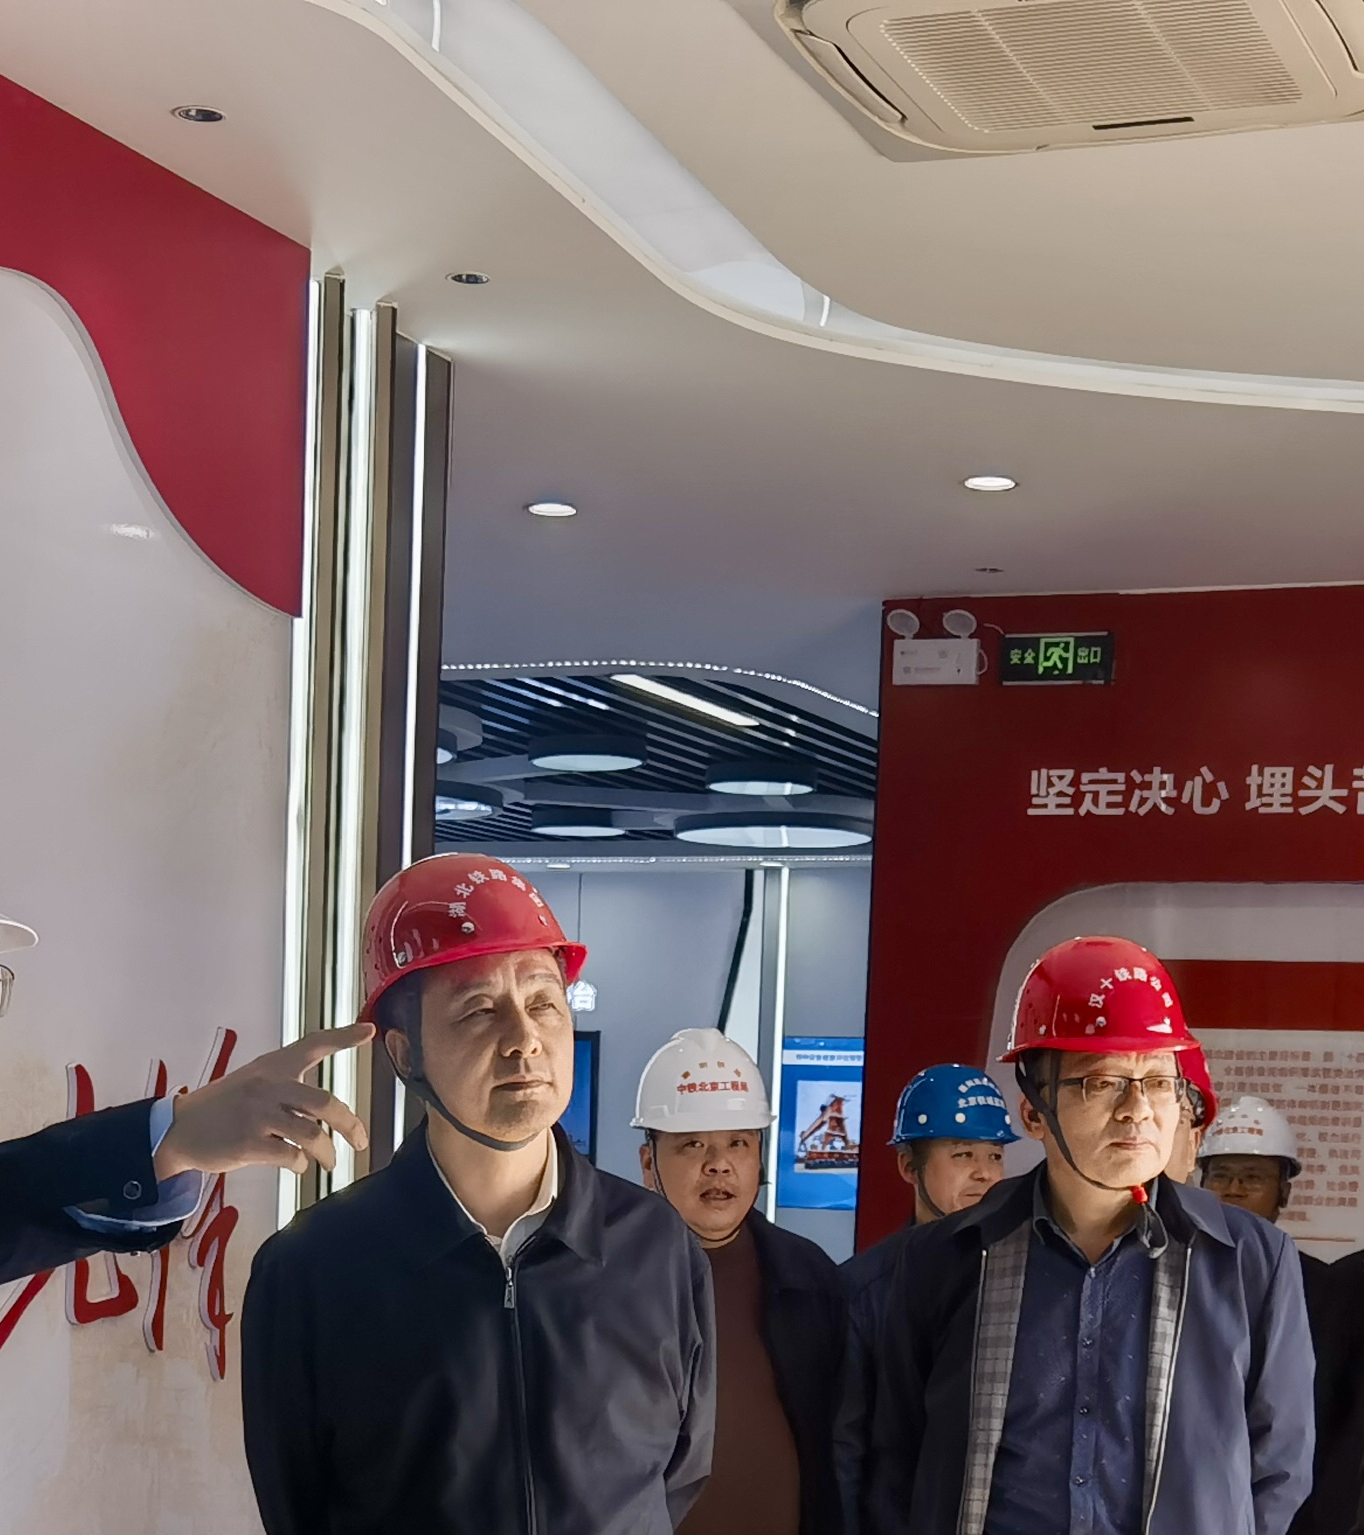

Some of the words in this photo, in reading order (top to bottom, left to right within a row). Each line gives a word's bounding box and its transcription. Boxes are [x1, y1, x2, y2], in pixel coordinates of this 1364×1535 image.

[1010, 648, 1035, 664] 安全
[1077, 646, 1102, 664] 出口
[1028, 765, 1228, 818] 坚定决心
[676, 1081, 749, 1096] 中铁北京工程局
